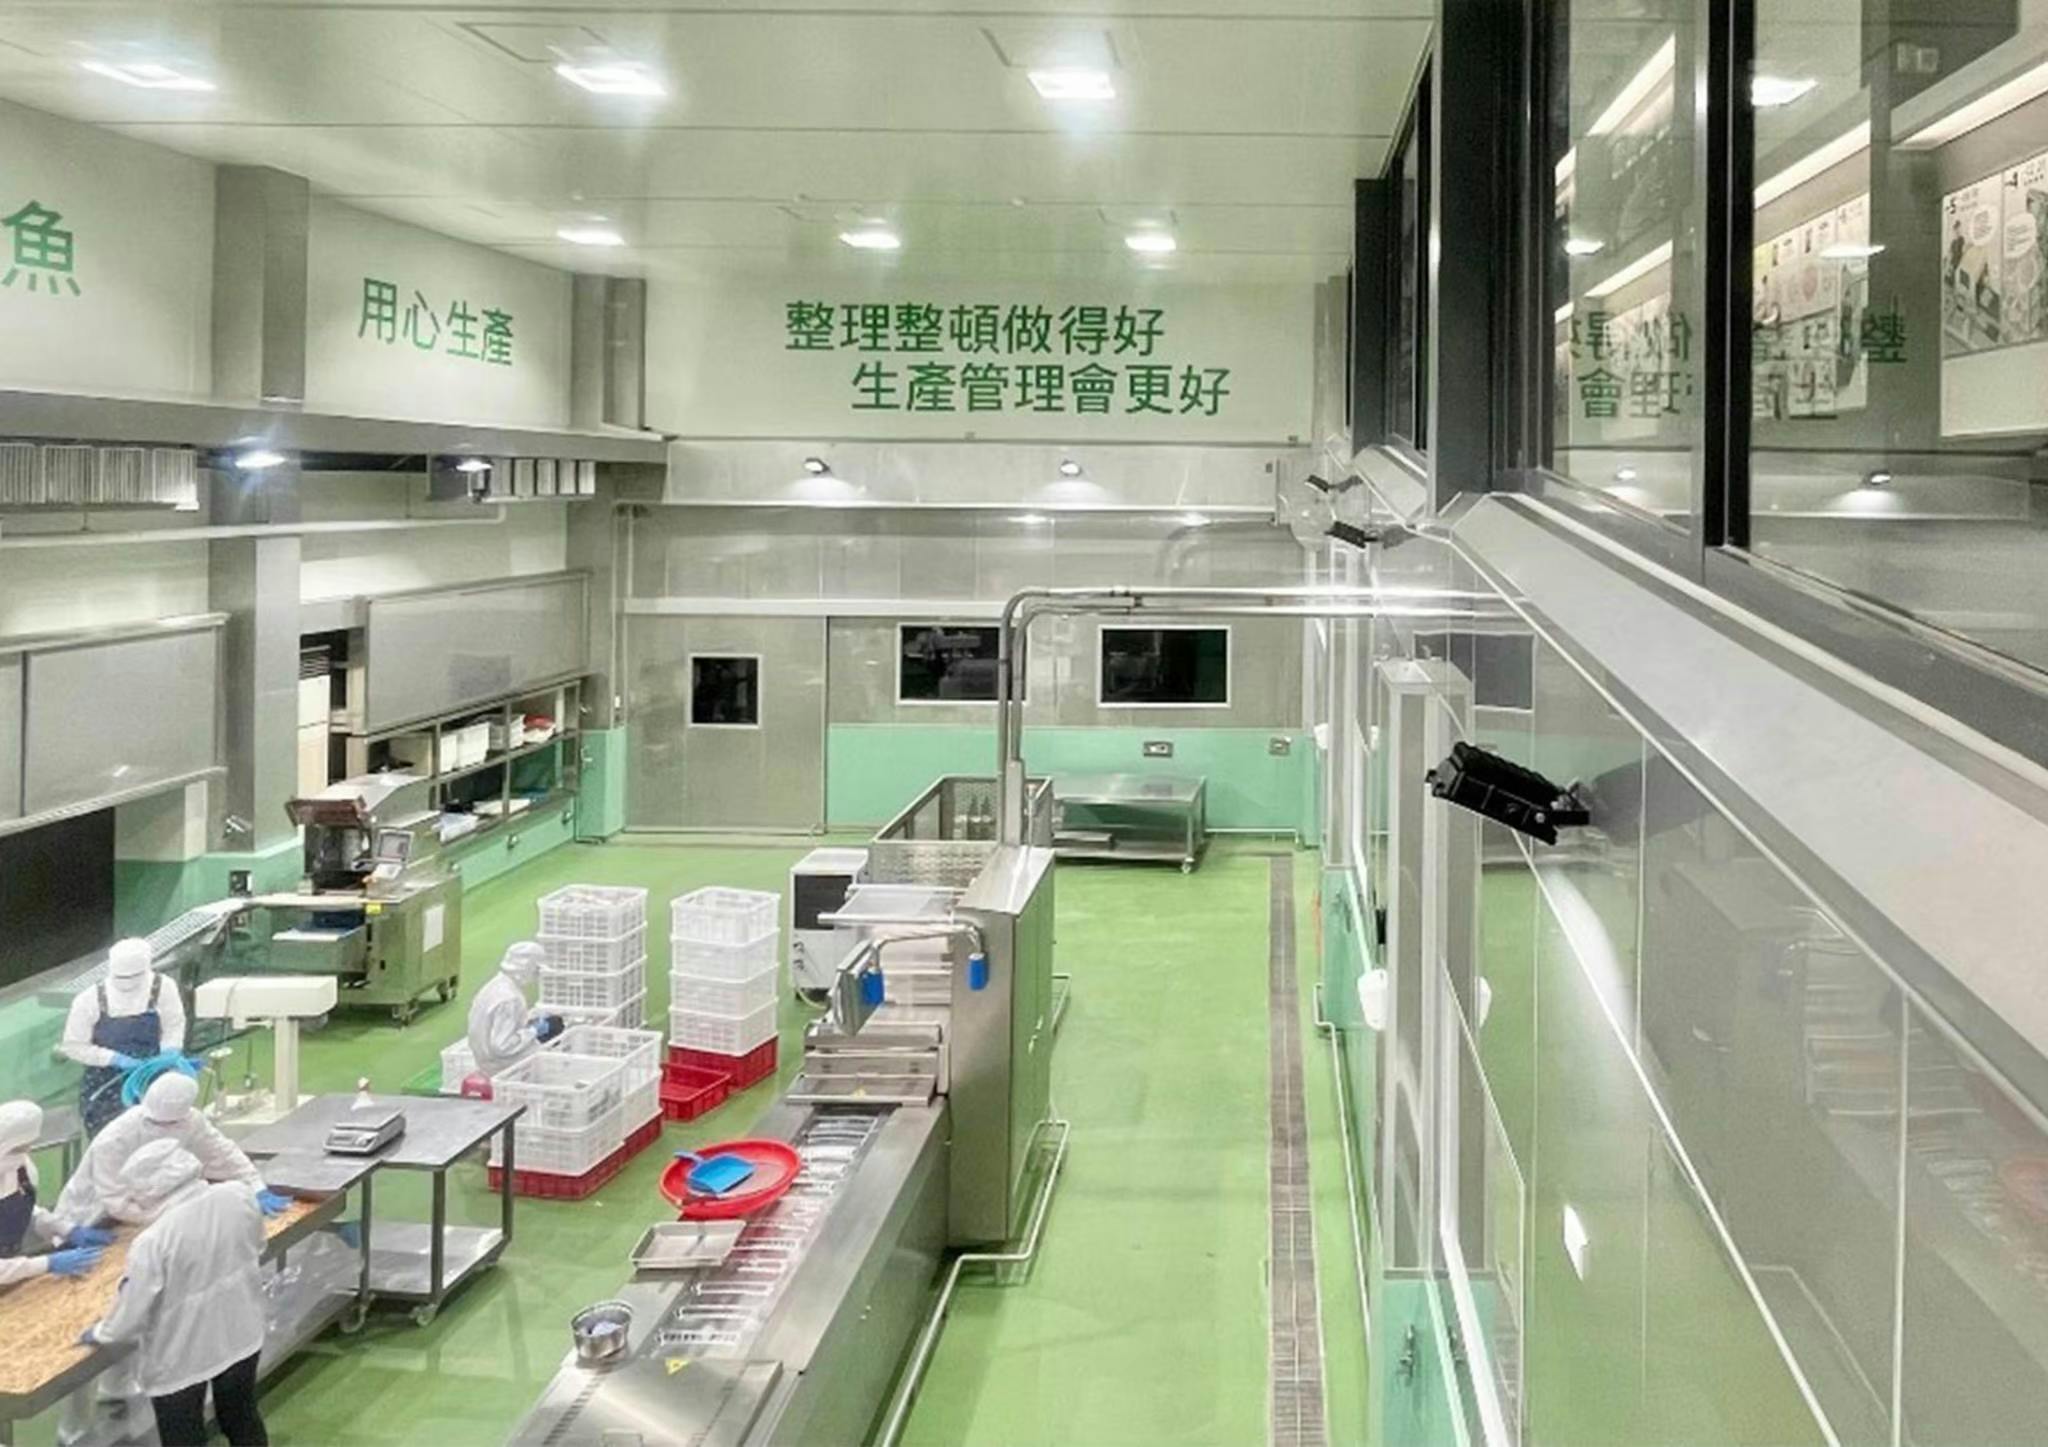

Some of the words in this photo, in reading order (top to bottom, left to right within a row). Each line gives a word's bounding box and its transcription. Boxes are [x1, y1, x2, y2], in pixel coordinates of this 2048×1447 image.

[2, 199, 82, 297] 魚
[358, 276, 515, 367] 用心生產
[785, 300, 1165, 355] 整理整頓做得好
[851, 361, 1231, 417] 生產管理會更好
